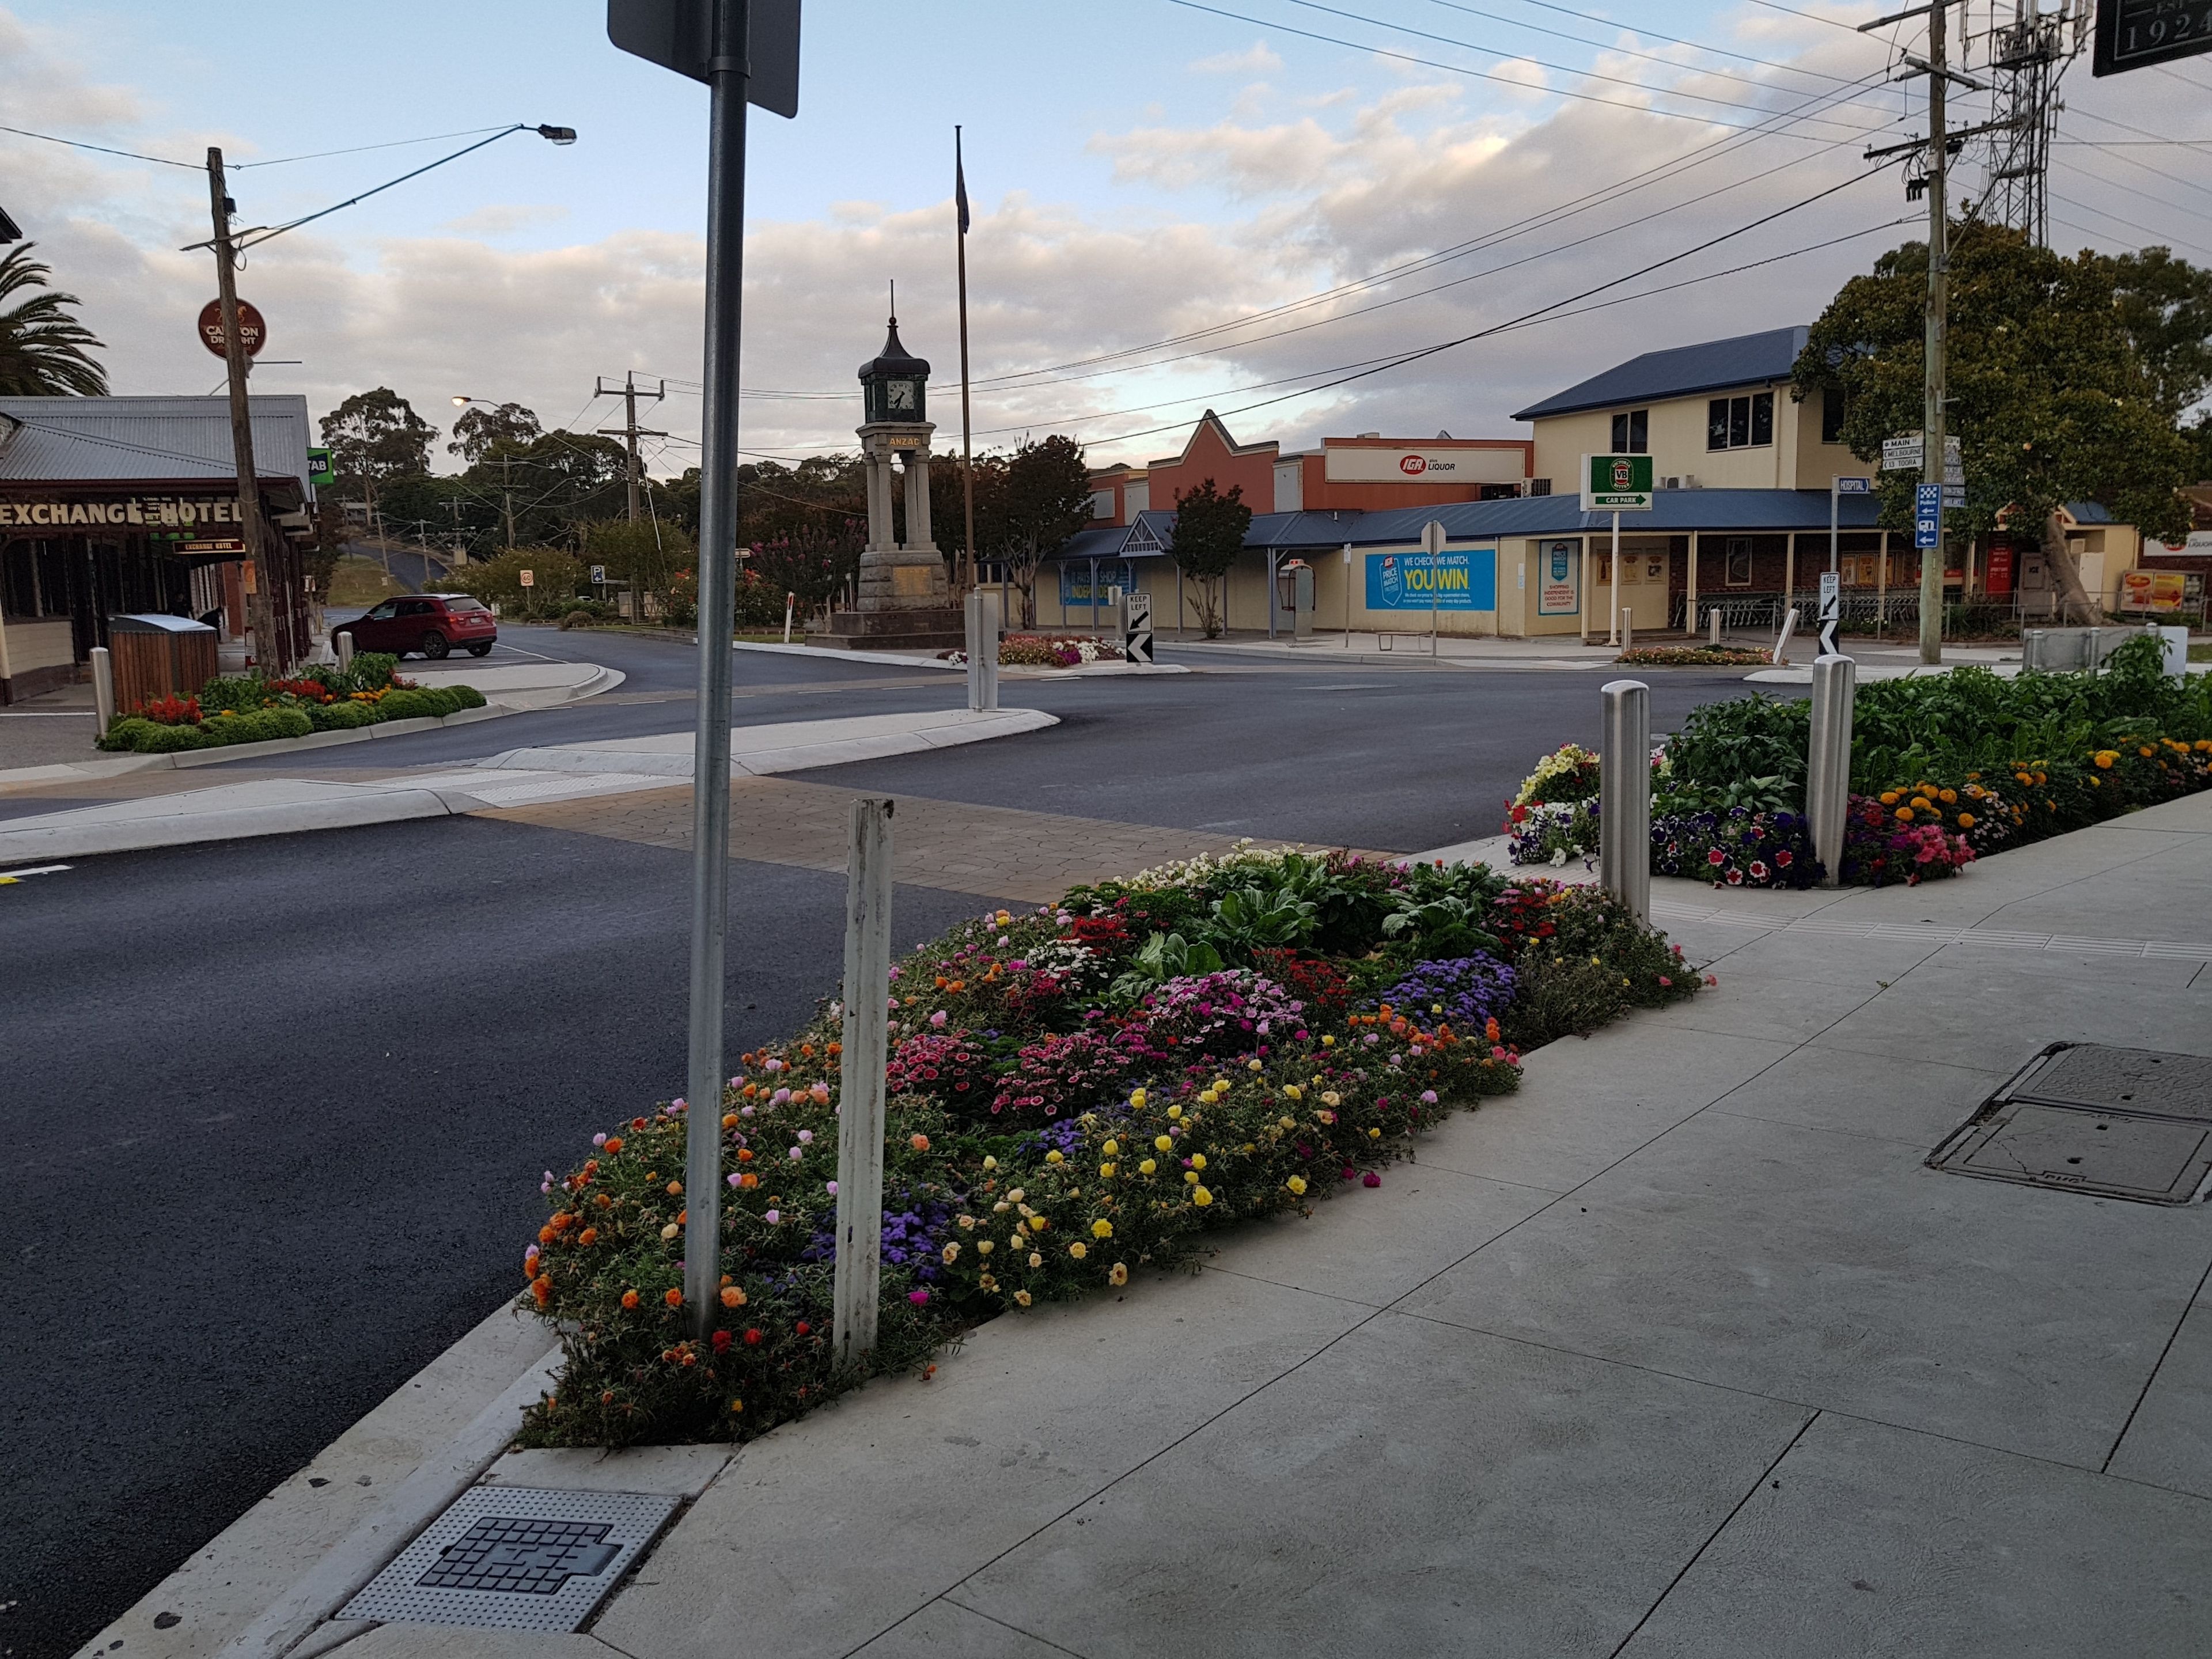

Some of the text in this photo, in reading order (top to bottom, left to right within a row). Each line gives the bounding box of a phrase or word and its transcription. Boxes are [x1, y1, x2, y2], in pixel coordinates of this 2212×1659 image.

[2126, 10, 2212, 51] 1924
[1888, 448, 1921, 457] MELBOURNE
[1402, 459, 1424, 470] IGA
[1899, 459, 1916, 467] TOORA
[1616, 470, 1627, 479] VB
[1840, 479, 1865, 491] HOSPITAL
[0, 503, 143, 525] EXCHANGE
[160, 502, 243, 525] HOTEL
[1404, 557, 1413, 566] WE
[1436, 556, 1446, 566] WE
[593, 567, 601, 575] P
[1382, 567, 1397, 580] PRICE
[1100, 571, 1116, 584] SHOP
[1384, 576, 1399, 587] MATCH
[1404, 569, 1434, 590] YOU
